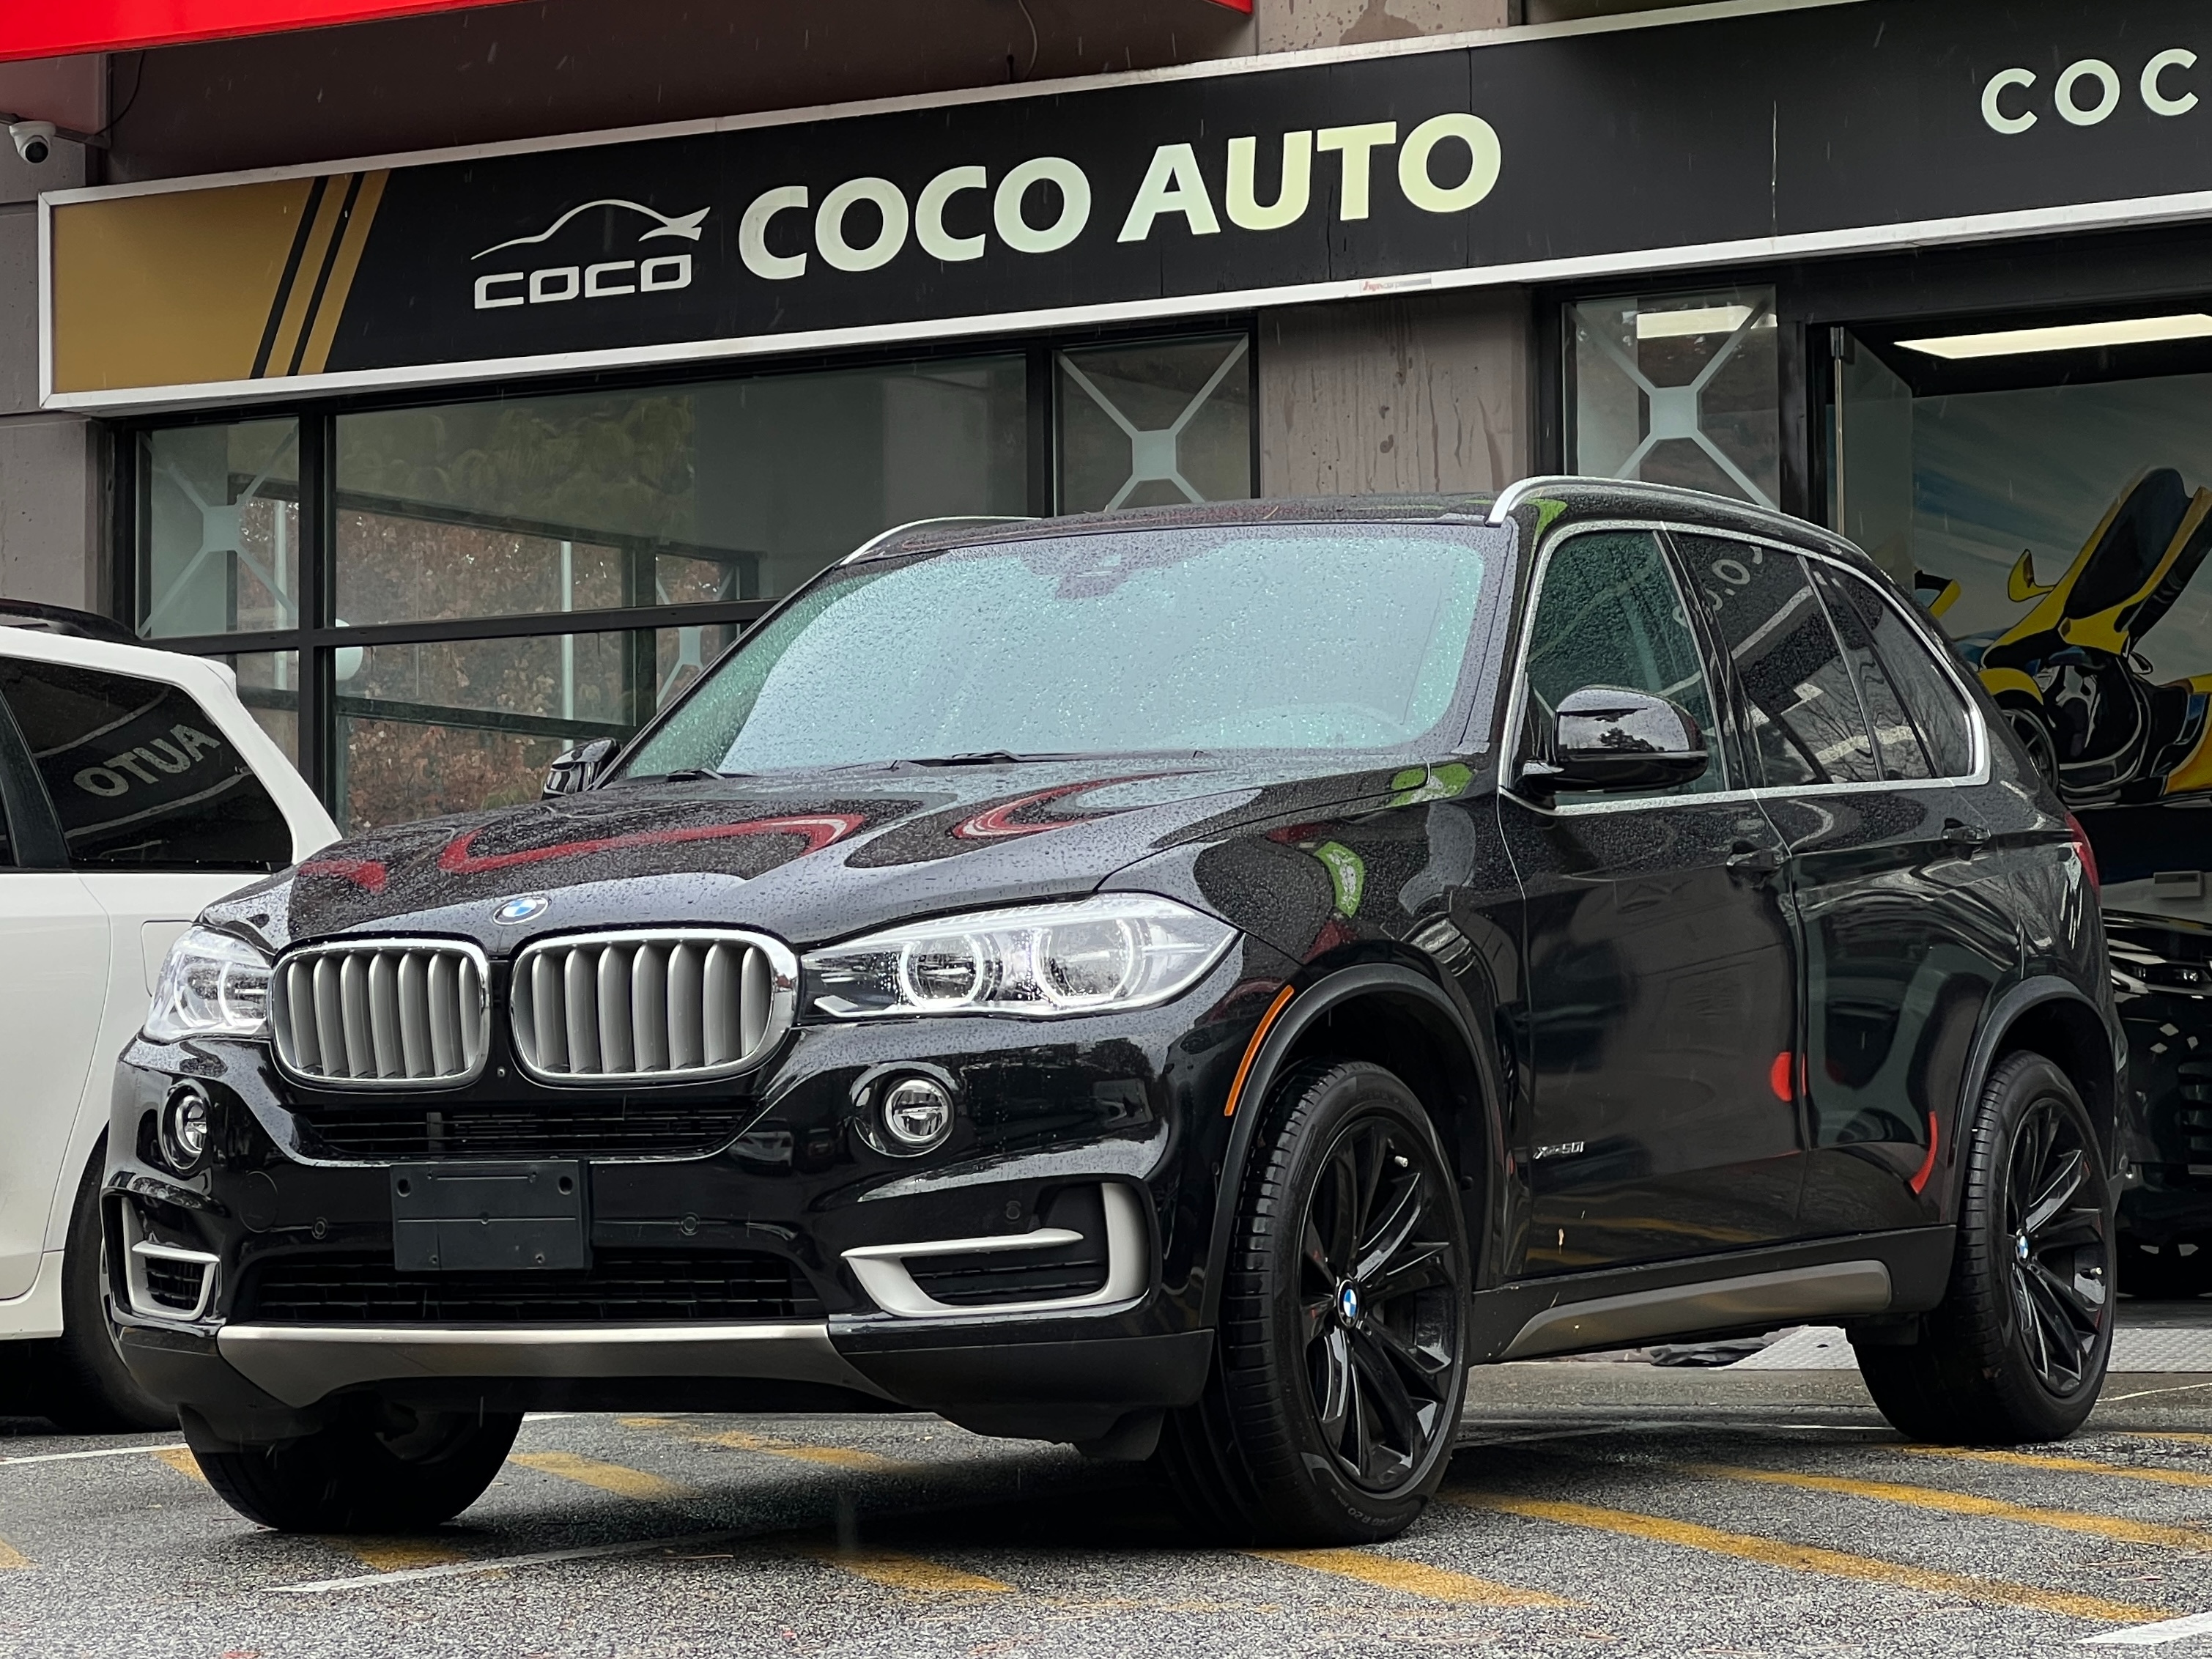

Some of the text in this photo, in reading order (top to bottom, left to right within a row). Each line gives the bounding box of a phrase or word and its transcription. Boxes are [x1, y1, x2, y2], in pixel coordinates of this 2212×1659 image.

[1980, 48, 2199, 135] COC
[739, 113, 1501, 280] COCO AUTO
[474, 254, 692, 309] COCO
